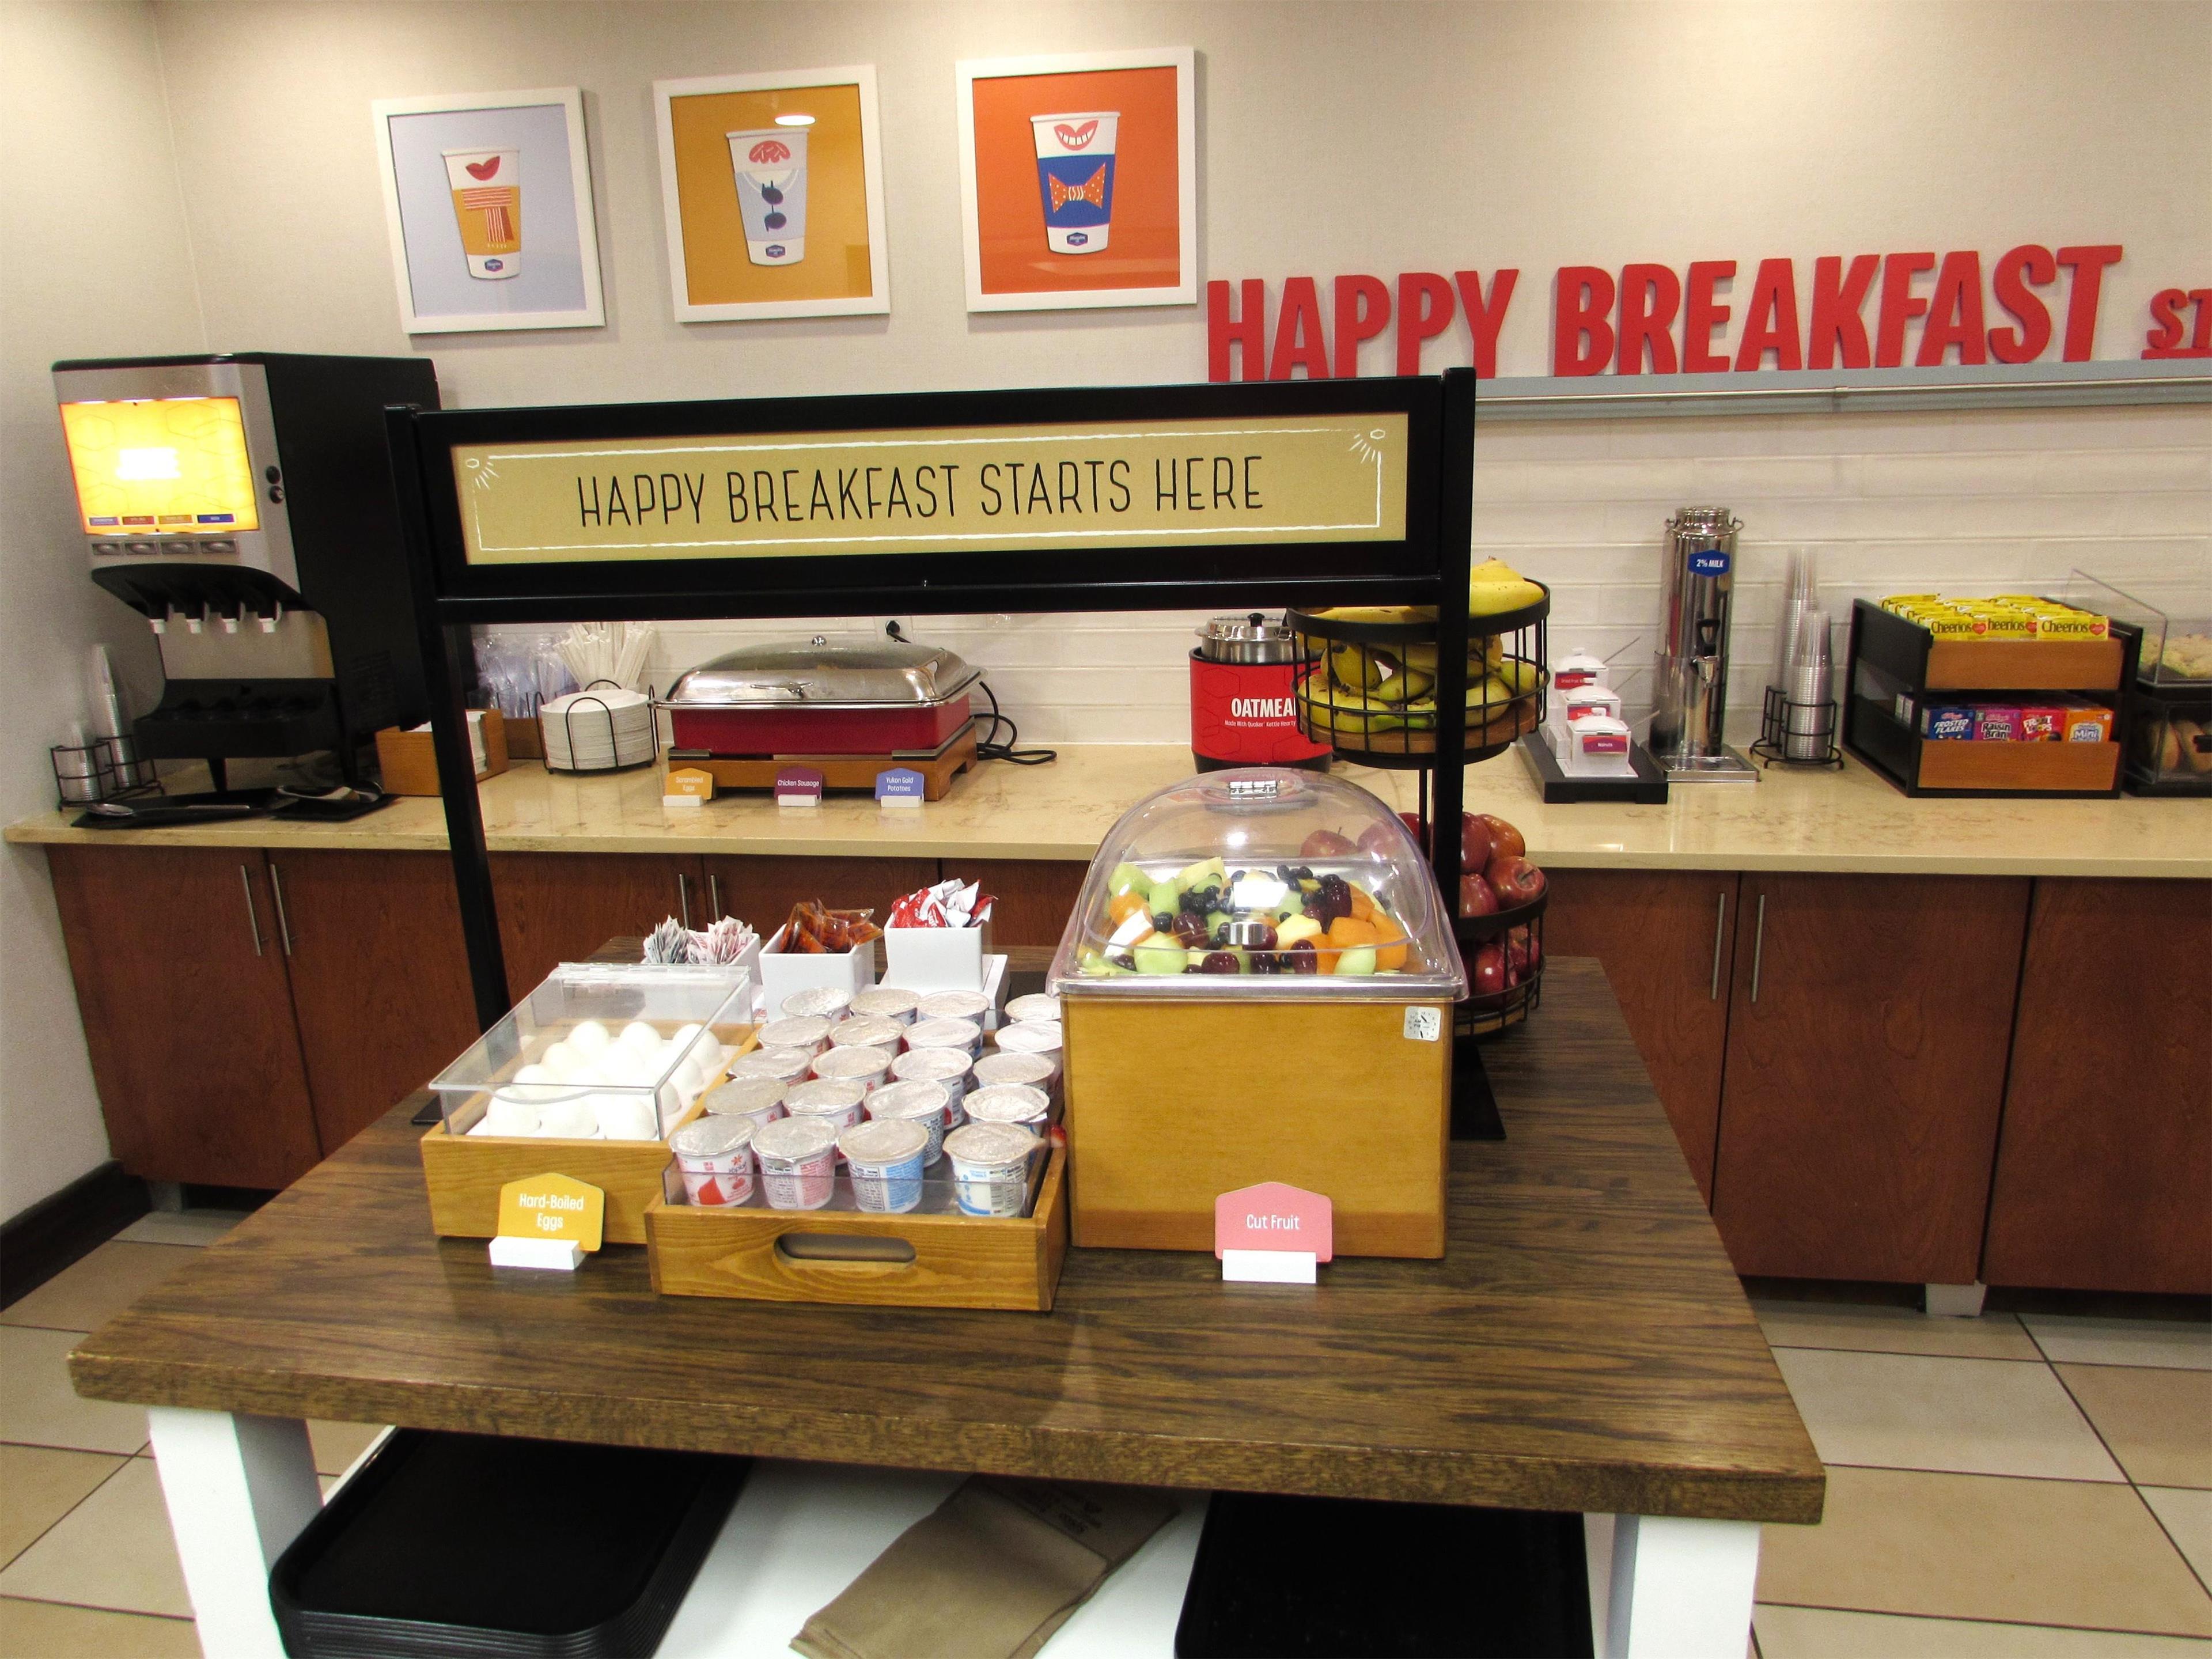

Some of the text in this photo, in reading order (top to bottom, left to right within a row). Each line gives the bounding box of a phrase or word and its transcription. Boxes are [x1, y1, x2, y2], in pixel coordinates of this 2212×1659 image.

[1207, 268, 1519, 382] HAPPY
[1552, 244, 2123, 378] BREAKFAST
[577, 456, 1264, 528] HAPPY BREAKFAST STARTS HERE
[1696, 559, 1724, 568] 2% MILK
[1931, 621, 1972, 634] Cheerios
[1988, 618, 2025, 631] heerios
[2042, 620, 2088, 633] Cheerios
[1934, 718, 1969, 729] FROSTED
[1935, 725, 1965, 734] FLAKES
[1982, 722, 2011, 733] Raisin
[1983, 730, 2007, 740] Bran
[2074, 729, 2097, 739] Mini
[797, 779, 819, 788] Sausage
[519, 1193, 585, 1210] Hard-Boiled
[536, 1213, 563, 1232] Eggs
[1246, 1214, 1300, 1230] Cut Fruit
